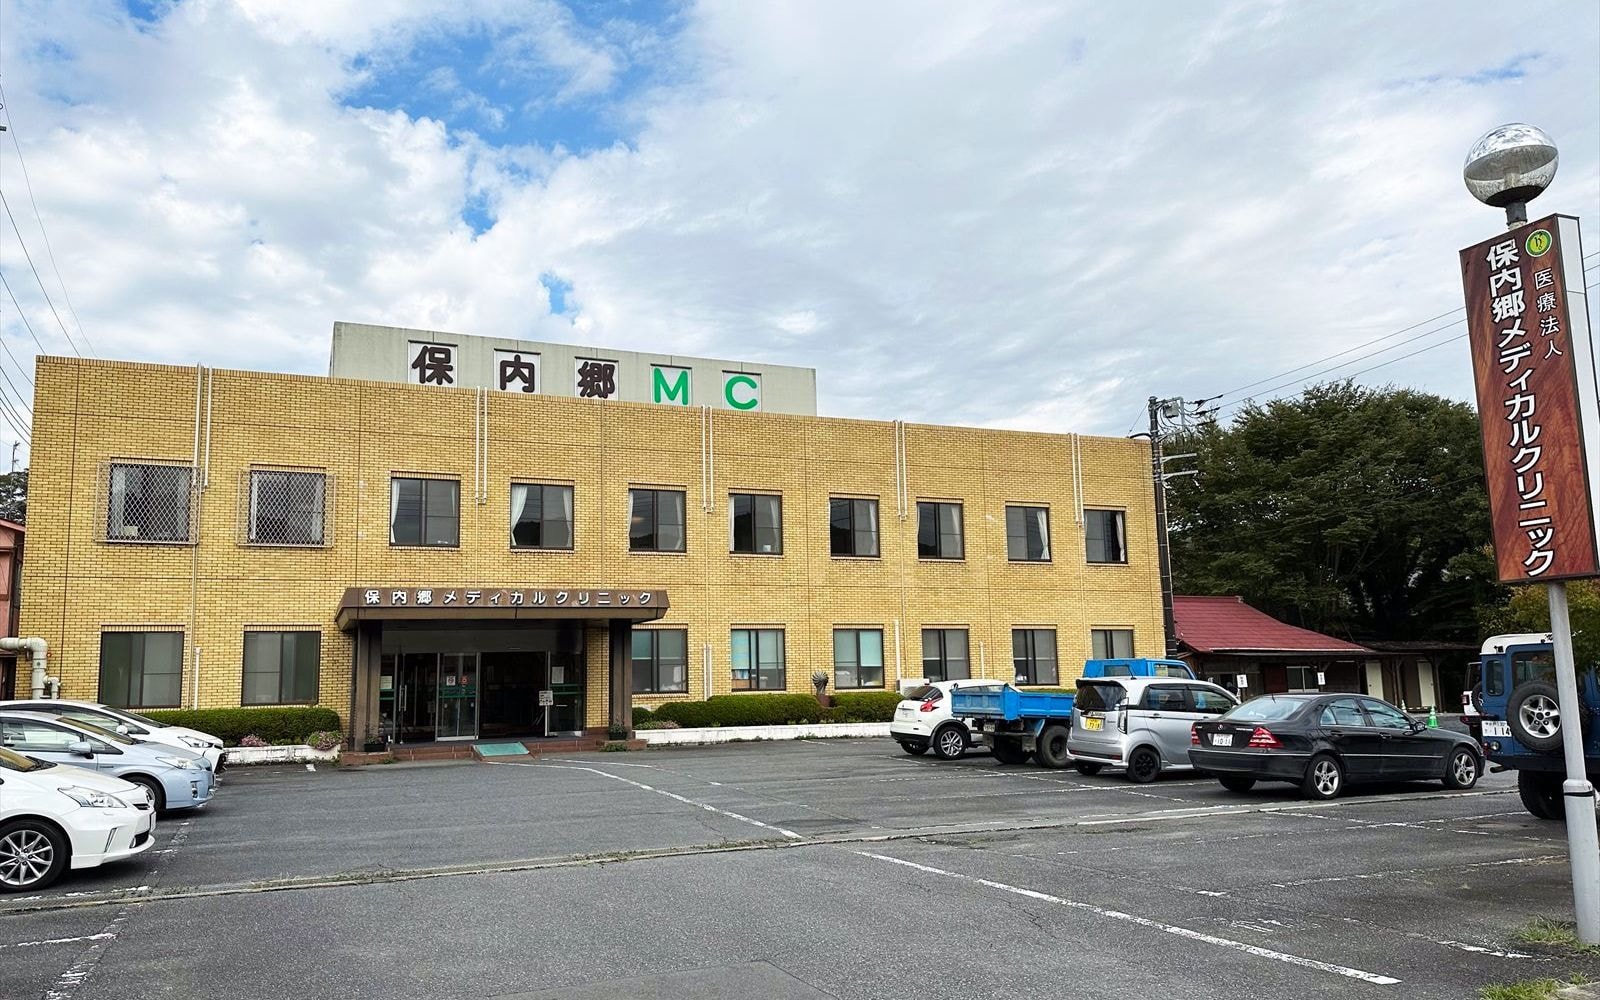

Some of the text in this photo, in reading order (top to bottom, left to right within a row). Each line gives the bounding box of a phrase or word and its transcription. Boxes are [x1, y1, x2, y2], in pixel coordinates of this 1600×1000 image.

[1534, 267, 1563, 359] 医療法人
[1486, 238, 1556, 578] 保内郷メディカルクリニック
[364, 589, 652, 605] 保内郷メディカルクリニック
